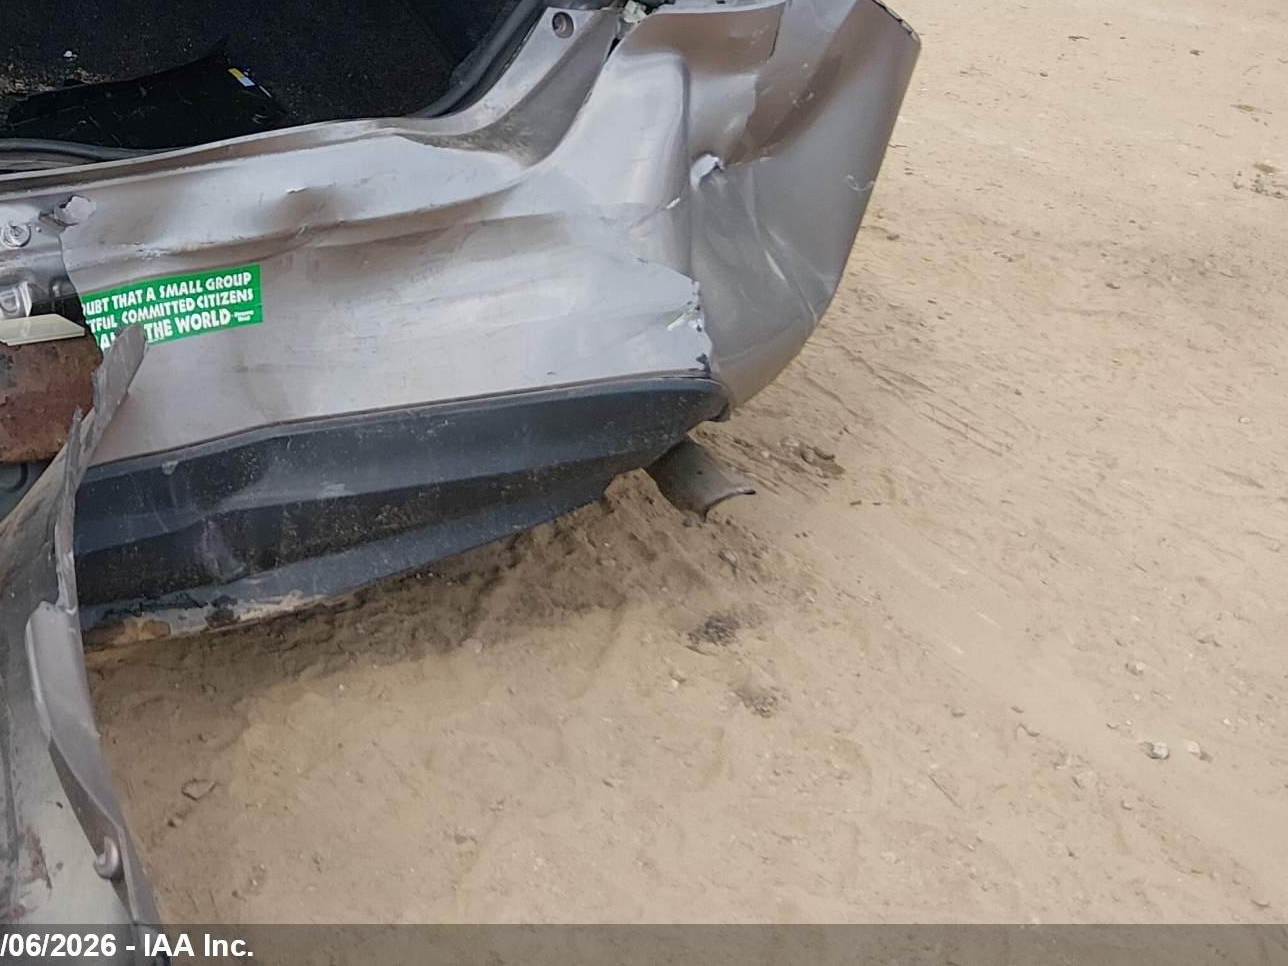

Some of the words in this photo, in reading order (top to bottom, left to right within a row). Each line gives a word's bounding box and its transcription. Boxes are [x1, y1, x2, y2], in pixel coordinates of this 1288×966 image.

[112, 289, 143, 309] THAT
[146, 287, 156, 302] A
[159, 280, 203, 298] SMALL
[205, 272, 252, 290] GROUP
[86, 314, 118, 334] TFUL
[121, 297, 196, 324] COMMITTED
[197, 288, 254, 308] CITIZENS
[143, 319, 173, 343] THE
[174, 308, 231, 334] WORLD
